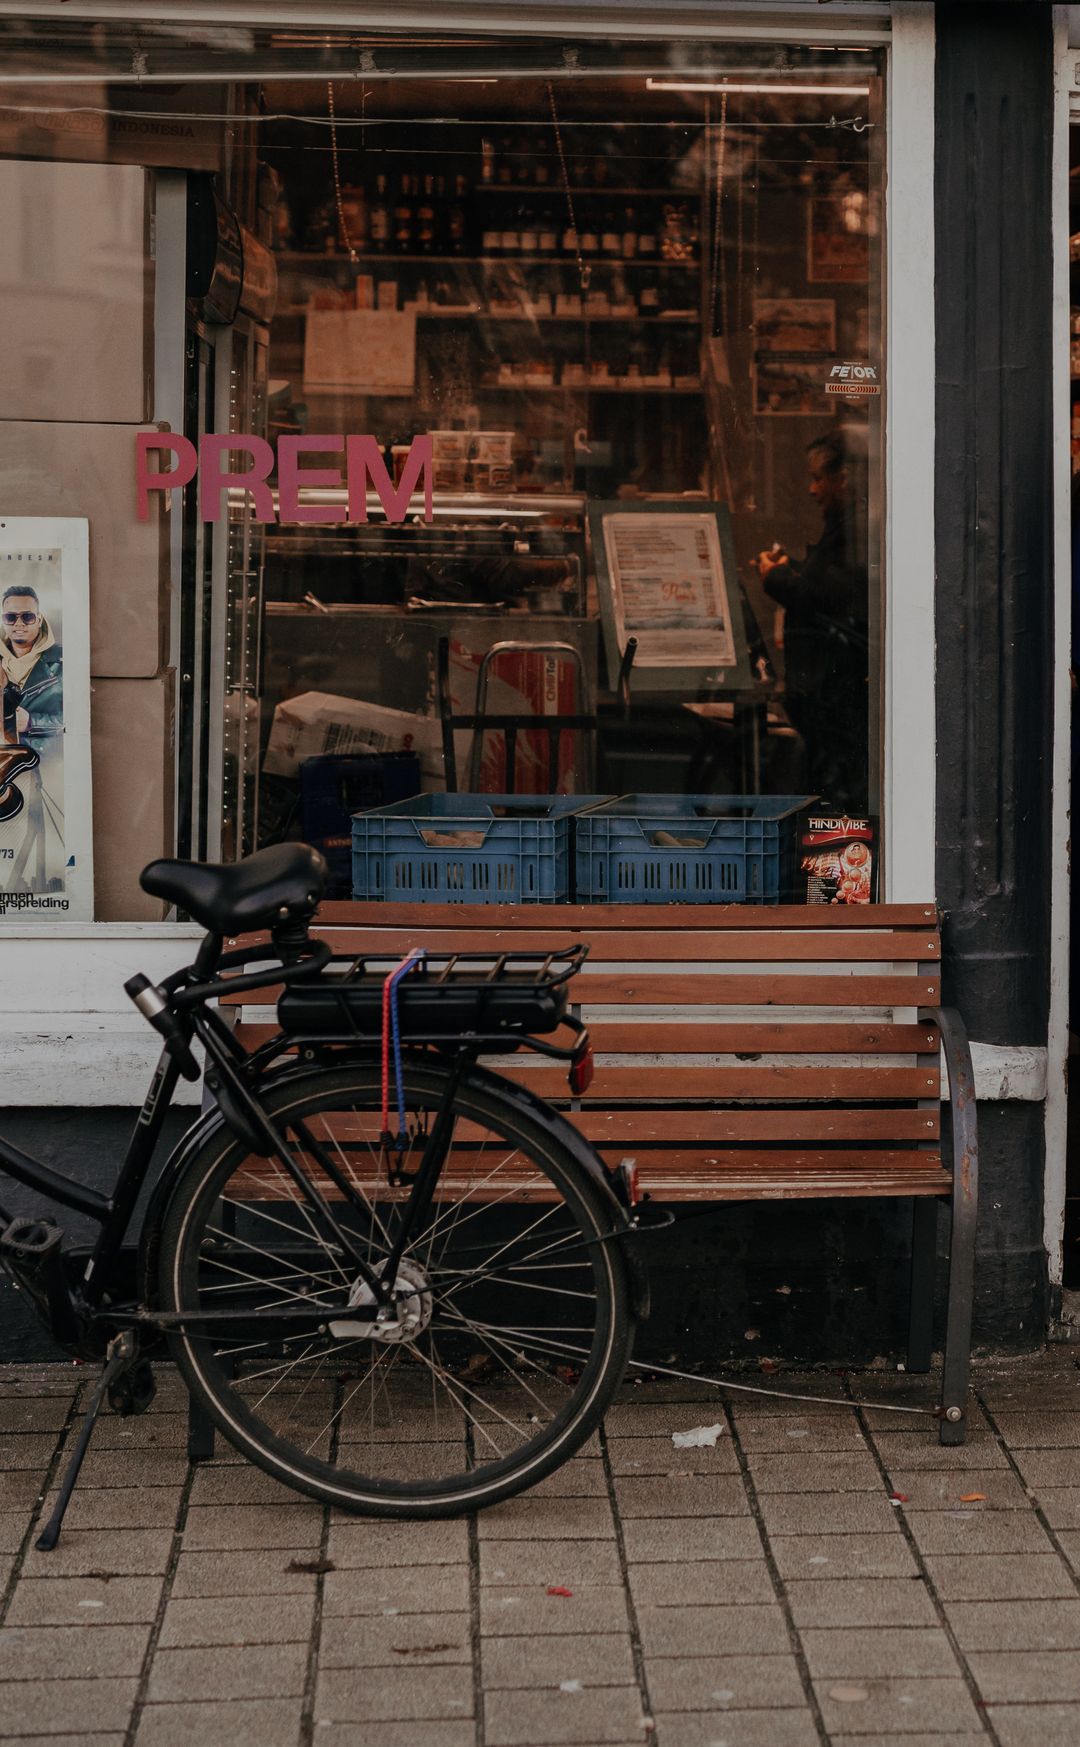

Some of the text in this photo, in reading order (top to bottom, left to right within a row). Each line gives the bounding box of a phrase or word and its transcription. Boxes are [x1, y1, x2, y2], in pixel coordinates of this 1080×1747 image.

[112, 120, 195, 138] INDONESIA
[136, 432, 433, 523] PREM
[0, 848, 14, 859] 73
